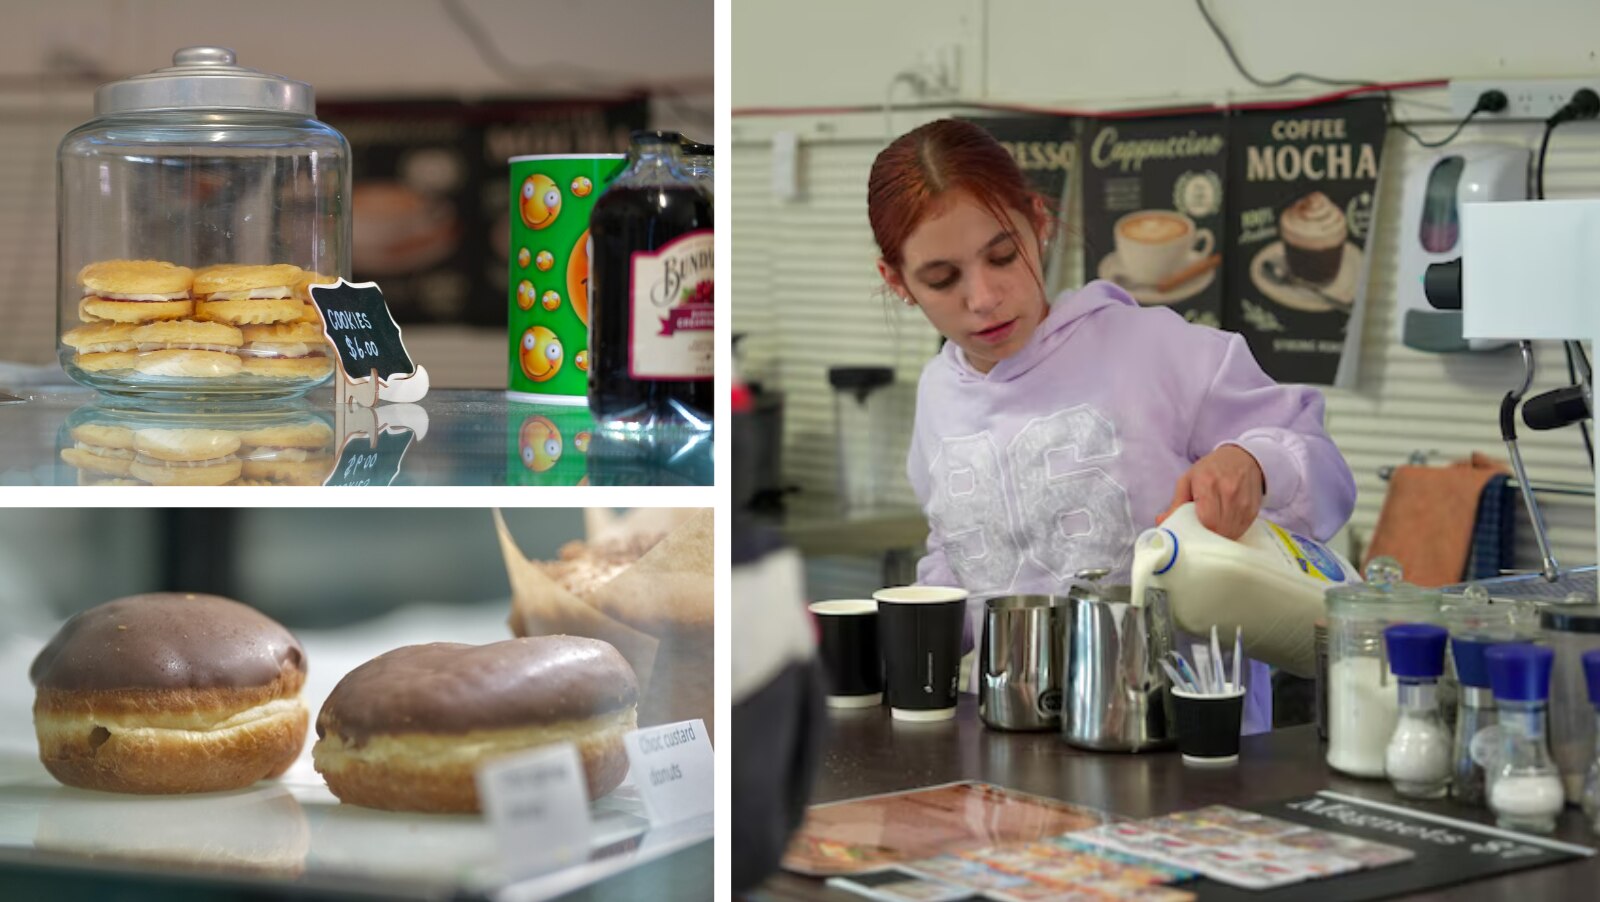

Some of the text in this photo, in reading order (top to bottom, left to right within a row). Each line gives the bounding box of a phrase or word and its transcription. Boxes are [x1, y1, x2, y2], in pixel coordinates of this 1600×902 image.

[1271, 118, 1347, 141] COFFEE
[1090, 126, 1225, 172] Cappuccino
[1247, 143, 1378, 182] MOCHA
[327, 308, 373, 331] COOKIES
[344, 334, 379, 360] $6.00
[928, 403, 1137, 597] 96
[639, 721, 697, 755] Choc custard
[649, 763, 683, 787] donuts
